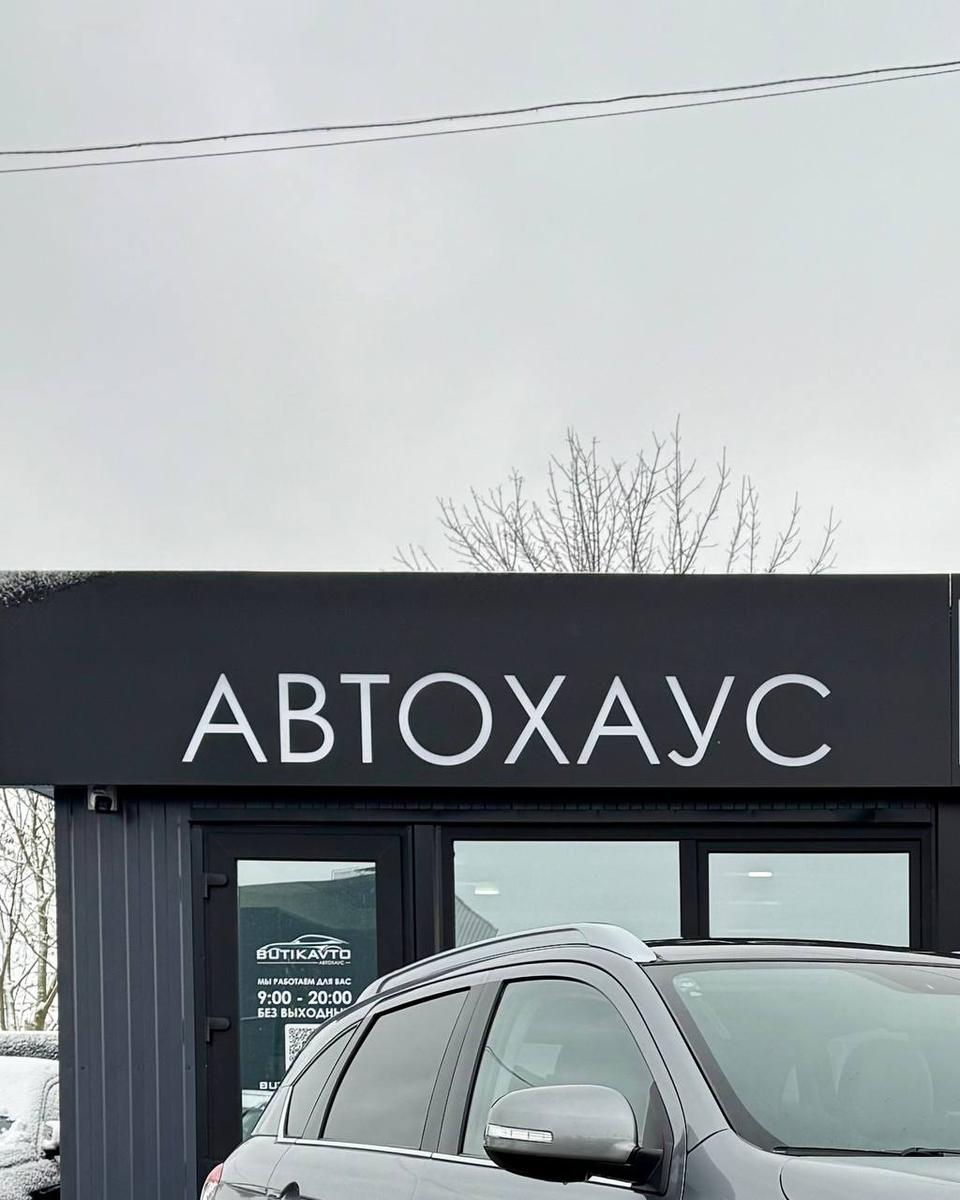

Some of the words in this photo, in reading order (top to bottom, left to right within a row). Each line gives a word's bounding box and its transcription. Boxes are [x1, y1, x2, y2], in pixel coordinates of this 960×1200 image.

[182, 672, 833, 767] АВТОХАУС
[256, 949, 351, 960] BUTIKAVTO
[257, 978, 272, 986] МЫ
[273, 978, 315, 986] РАБОТАЕМ
[316, 978, 333, 986] ДЛЯ
[334, 978, 352, 986] ВАС
[257, 990, 292, 1005] 9:00
[308, 990, 352, 1005] 20:00
[257, 1007, 278, 1019] БЕЗ
[280, 1007, 346, 1019] ВЫХОДНЫ
[259, 1081, 281, 1090] BU
